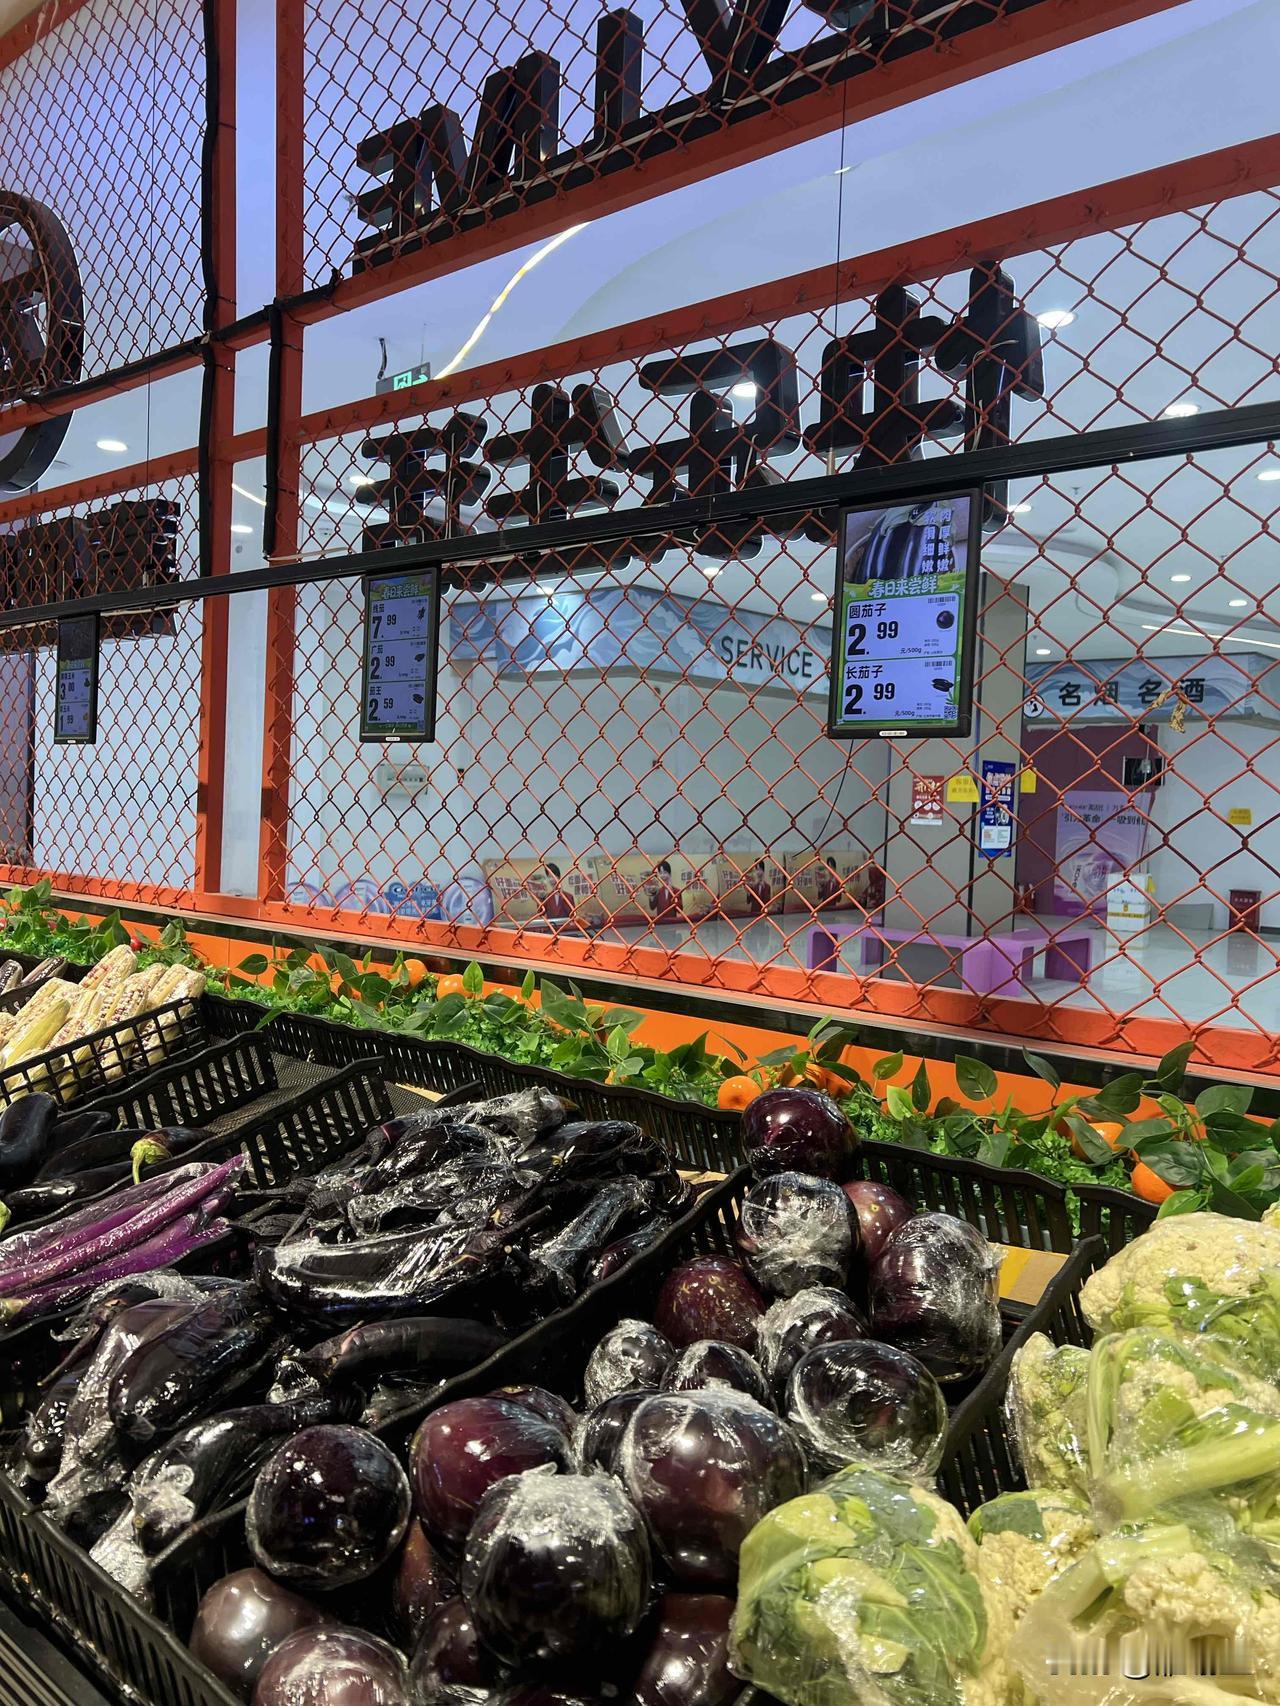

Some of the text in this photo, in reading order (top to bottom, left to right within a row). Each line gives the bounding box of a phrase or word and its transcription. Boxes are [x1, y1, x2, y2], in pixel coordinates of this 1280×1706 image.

[869, 576, 939, 598] 春日来尝鲜
[848, 604, 887, 619] 圆茄子
[720, 635, 814, 678] SERVICE
[900, 646, 922, 656] 元/500g
[846, 664, 883, 680] 长茄子
[1058, 677, 1206, 706] 名烟名酒
